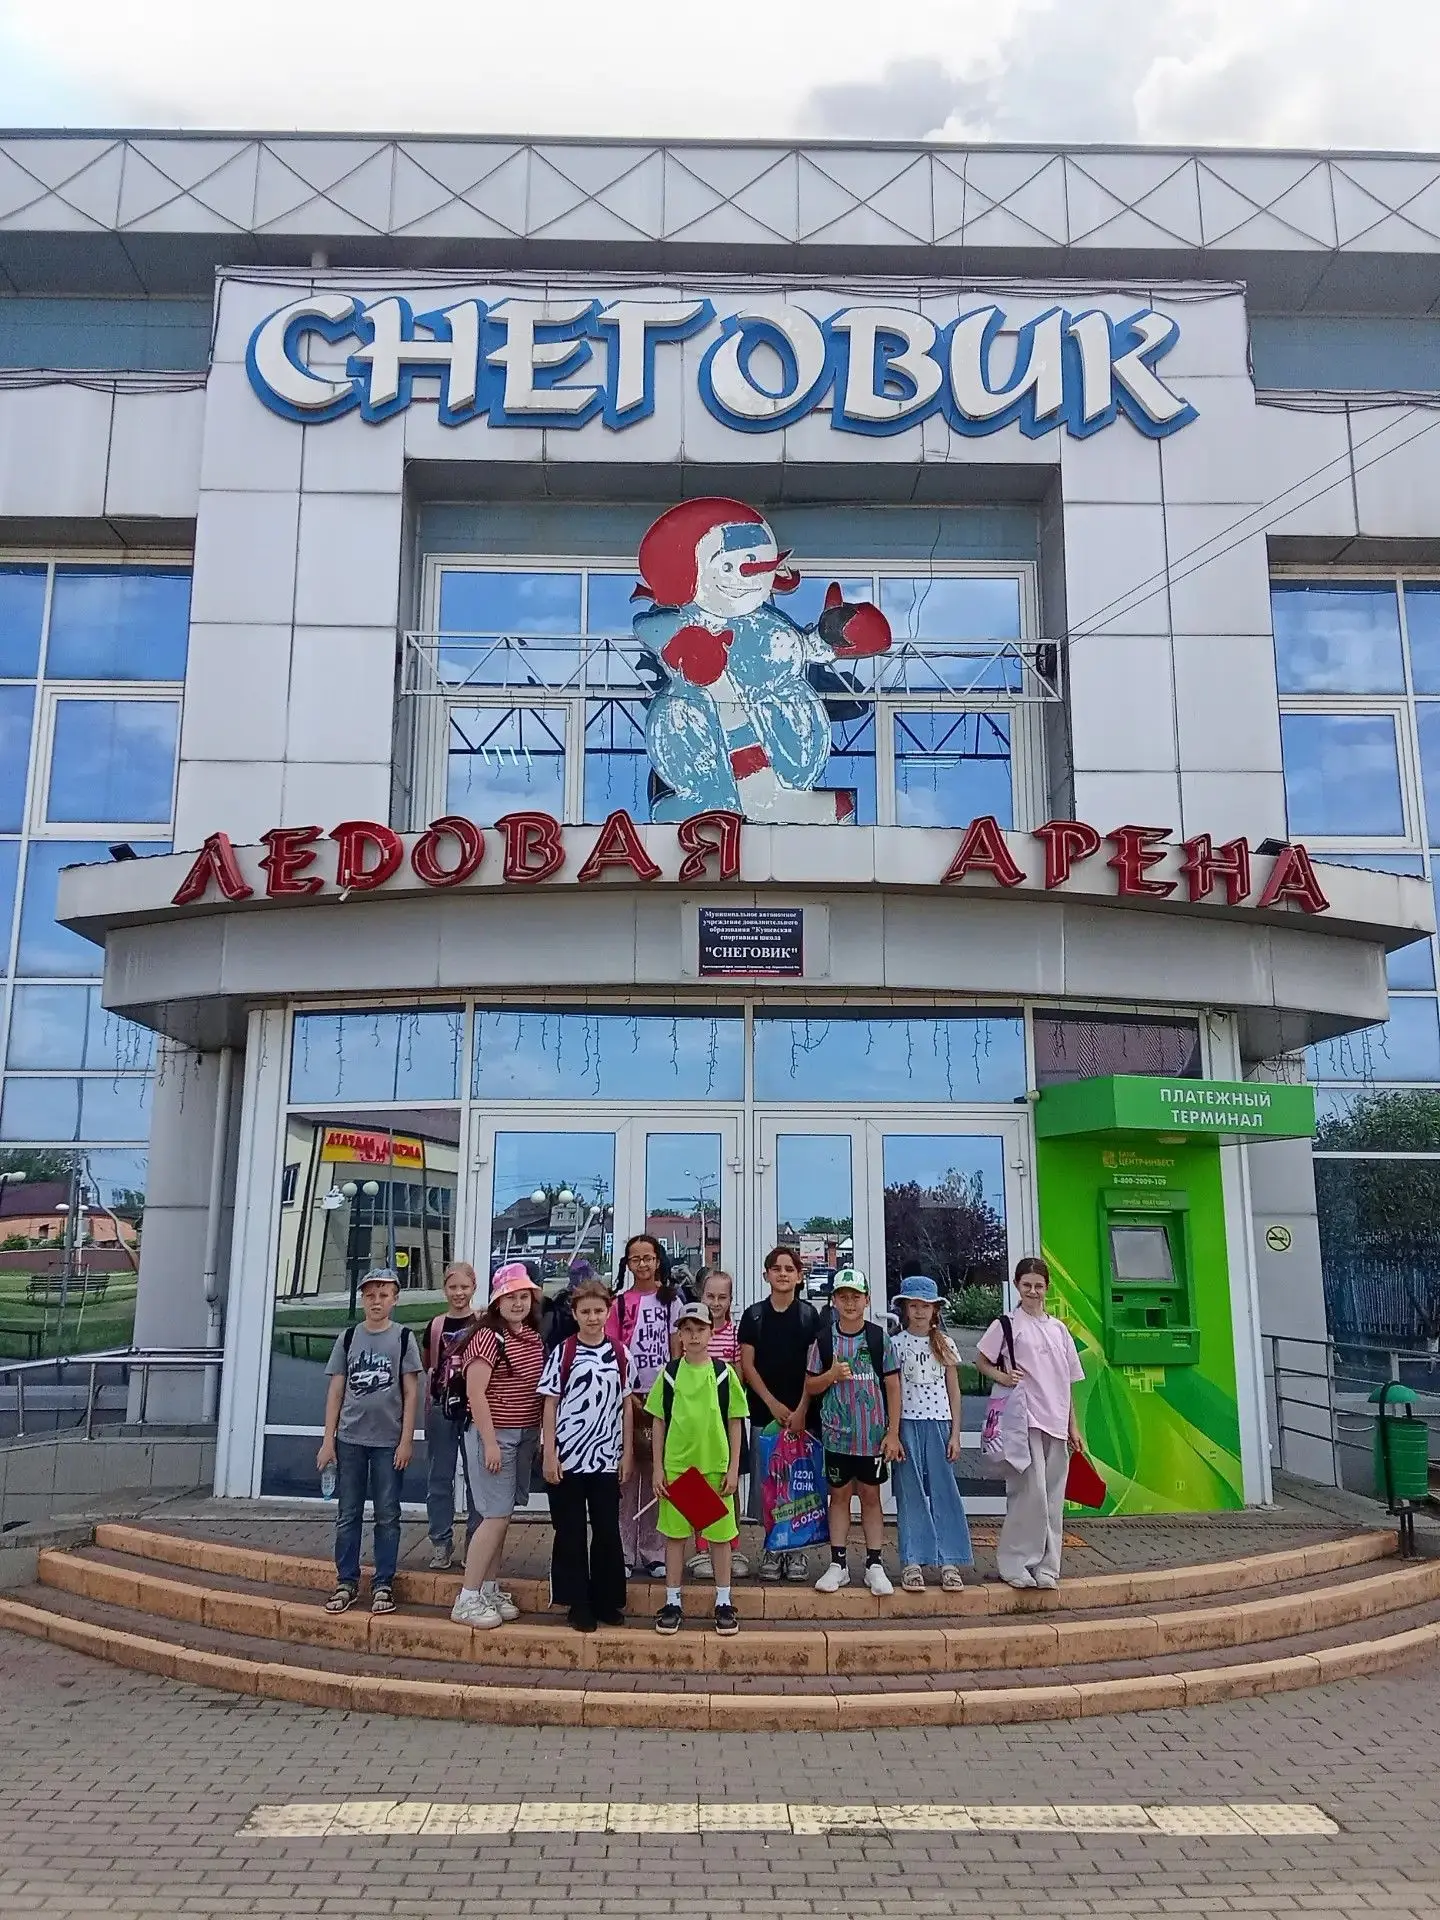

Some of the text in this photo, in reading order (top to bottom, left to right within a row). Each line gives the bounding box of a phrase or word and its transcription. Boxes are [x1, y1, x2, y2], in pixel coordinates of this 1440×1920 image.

[247, 292, 1199, 437] СНЕГОВИК
[172, 809, 1331, 914] ЛЕДОВАЯ АРЕНА
[705, 946, 798, 959] "СНЕГОВИК"
[1160, 1088, 1271, 1107] ПЛАТЕЖНЫЙ
[1171, 1109, 1263, 1127] ТЕРМИНАЛ
[874, 1456, 883, 1478] 7
[800, 1507, 826, 1525] OZON
